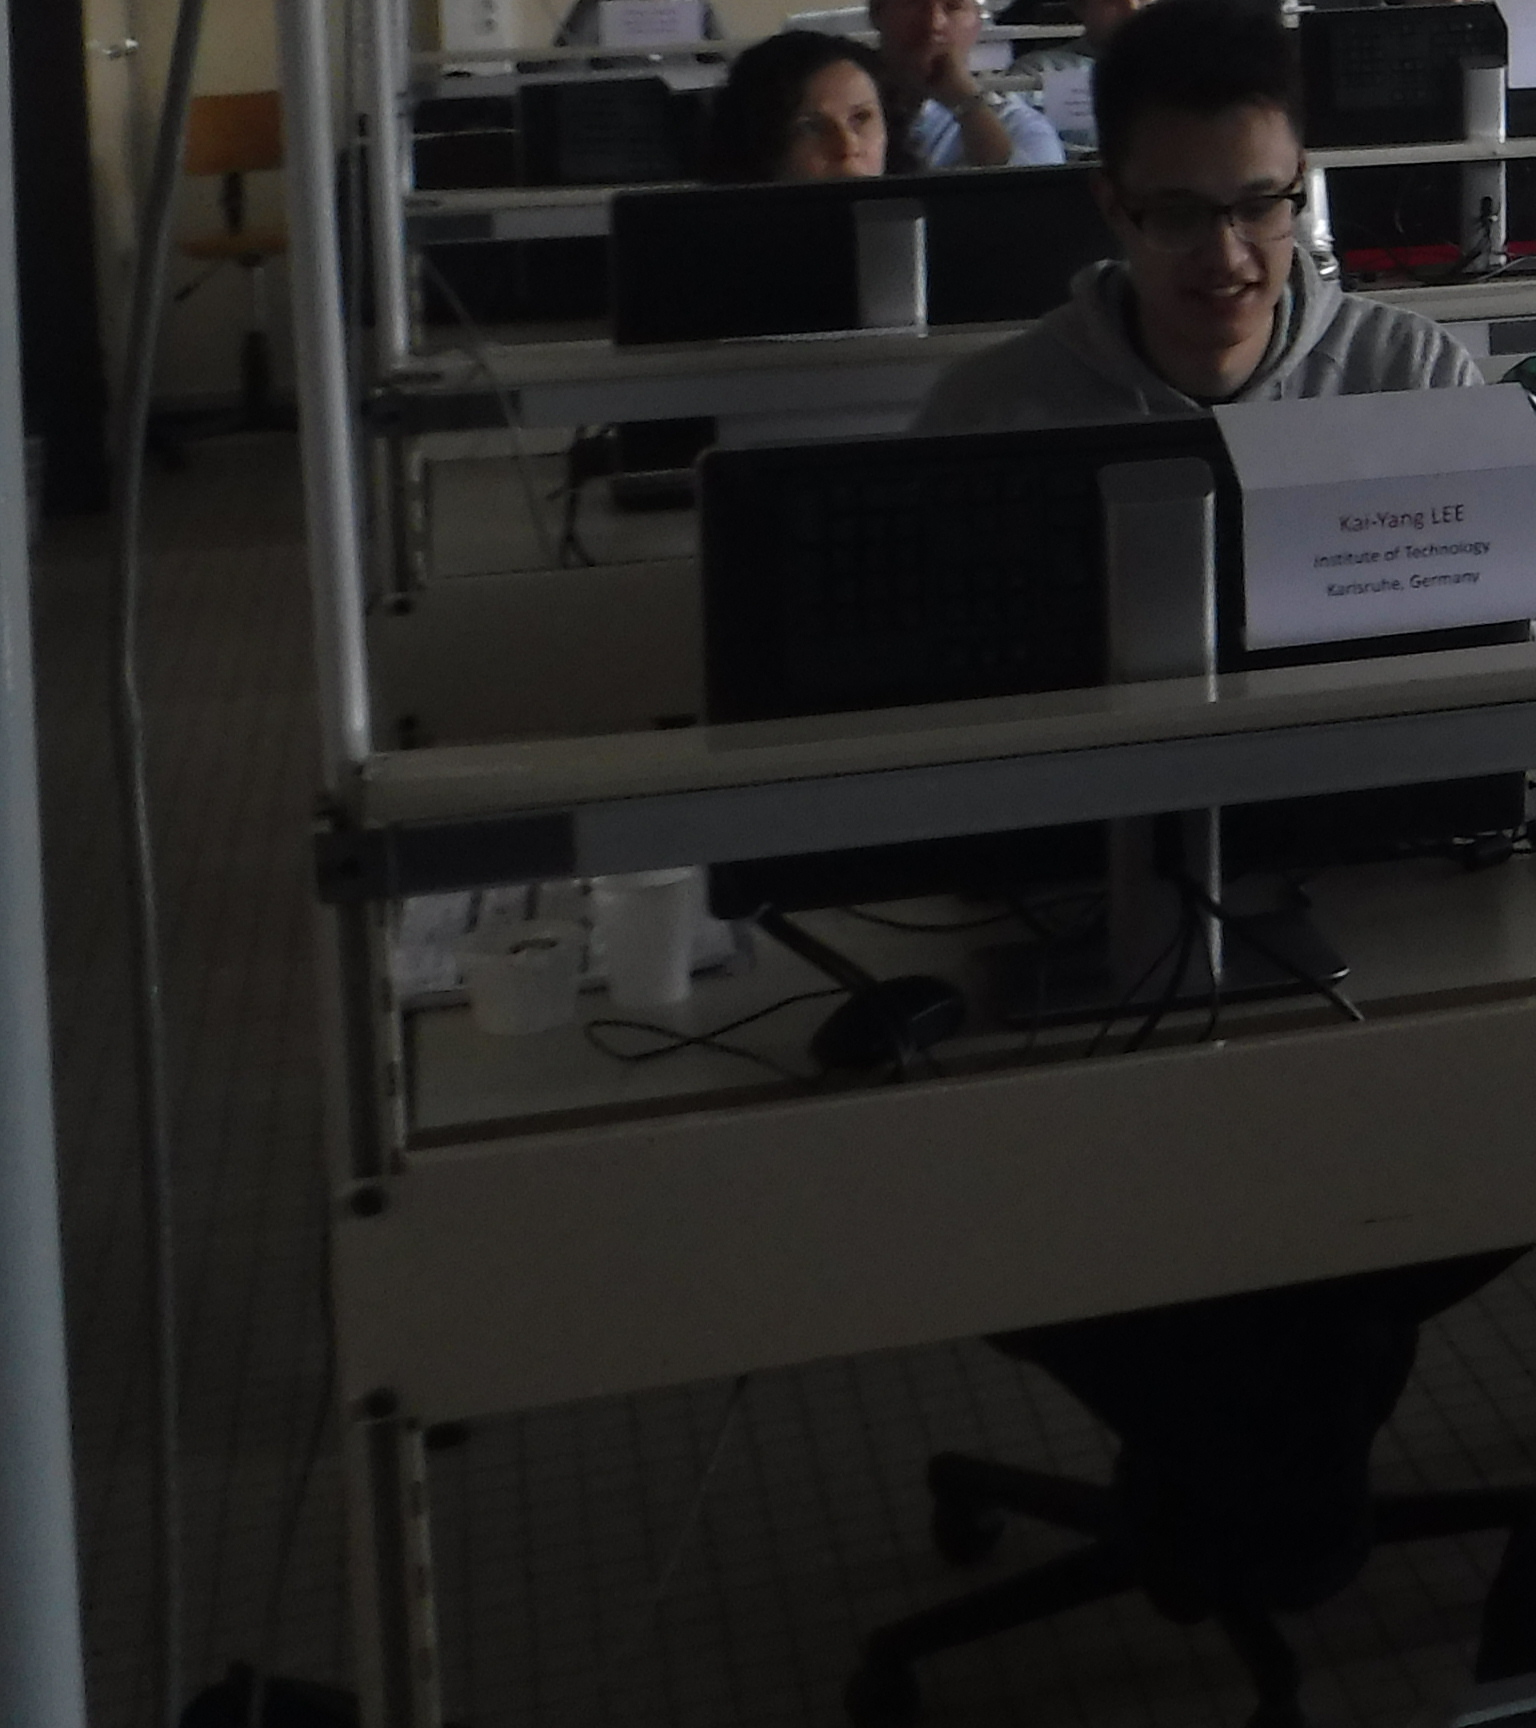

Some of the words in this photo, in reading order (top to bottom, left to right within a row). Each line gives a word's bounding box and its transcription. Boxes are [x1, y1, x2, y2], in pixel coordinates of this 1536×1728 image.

[1339, 510, 1425, 533] Kai-Yang
[1431, 503, 1465, 525] LEE
[1313, 550, 1381, 569] Institute
[1383, 545, 1400, 562] of
[1404, 540, 1491, 560] Technology
[1408, 570, 1481, 590] Germany
